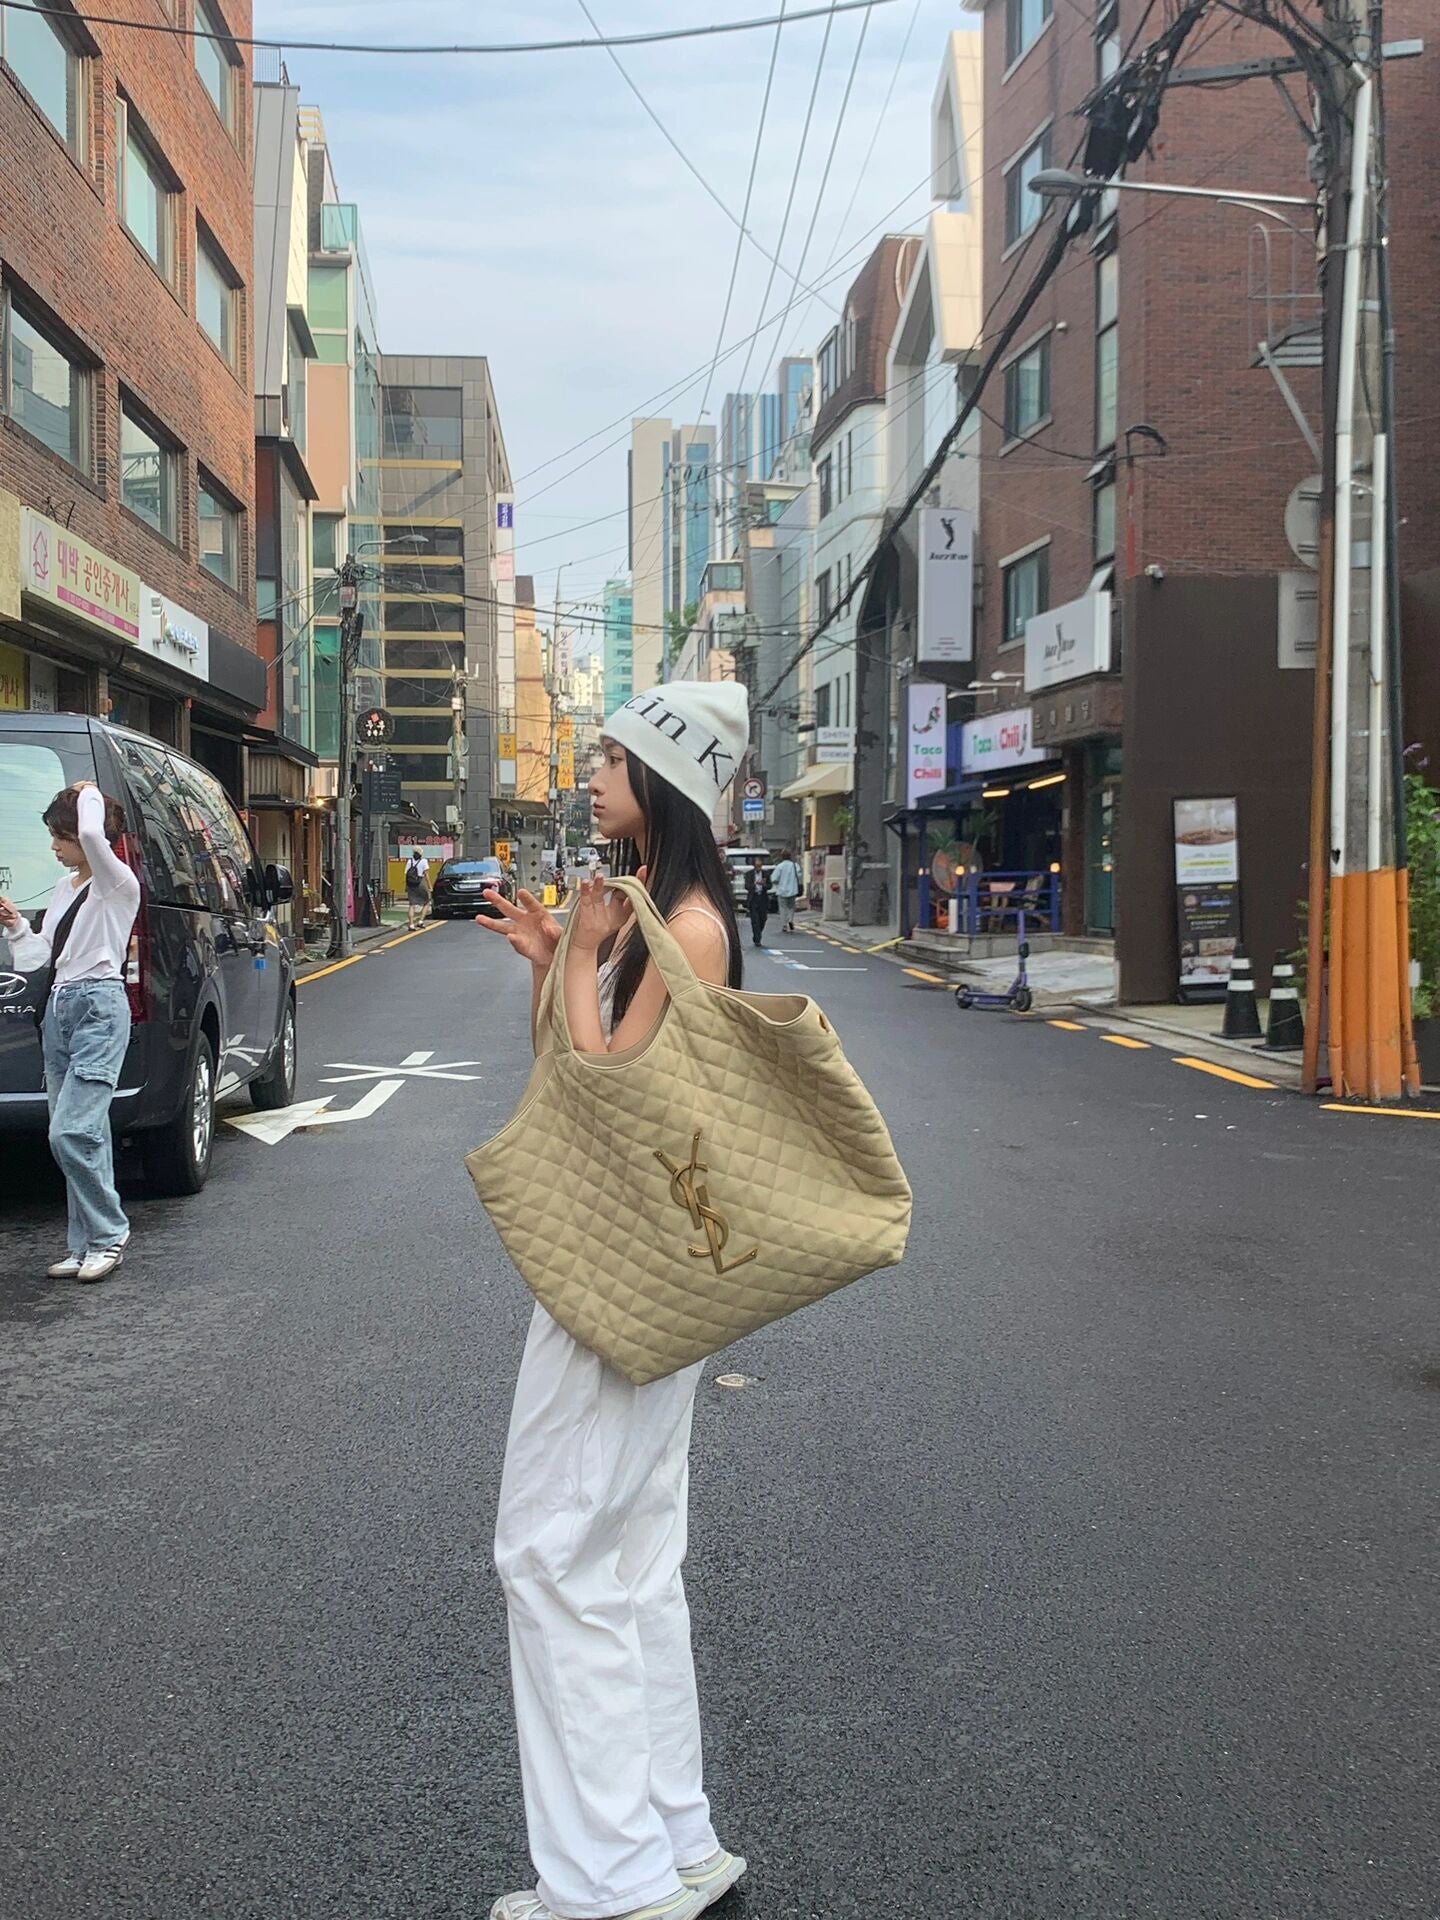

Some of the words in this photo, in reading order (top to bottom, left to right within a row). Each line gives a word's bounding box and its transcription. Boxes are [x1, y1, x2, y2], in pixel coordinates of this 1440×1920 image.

[57, 539, 80, 585] 대박
[83, 555, 130, 613] 공인중개사
[913, 744, 943, 755] Taco
[973, 734, 991, 755] Taco
[653, 1128, 758, 1274] YSL
